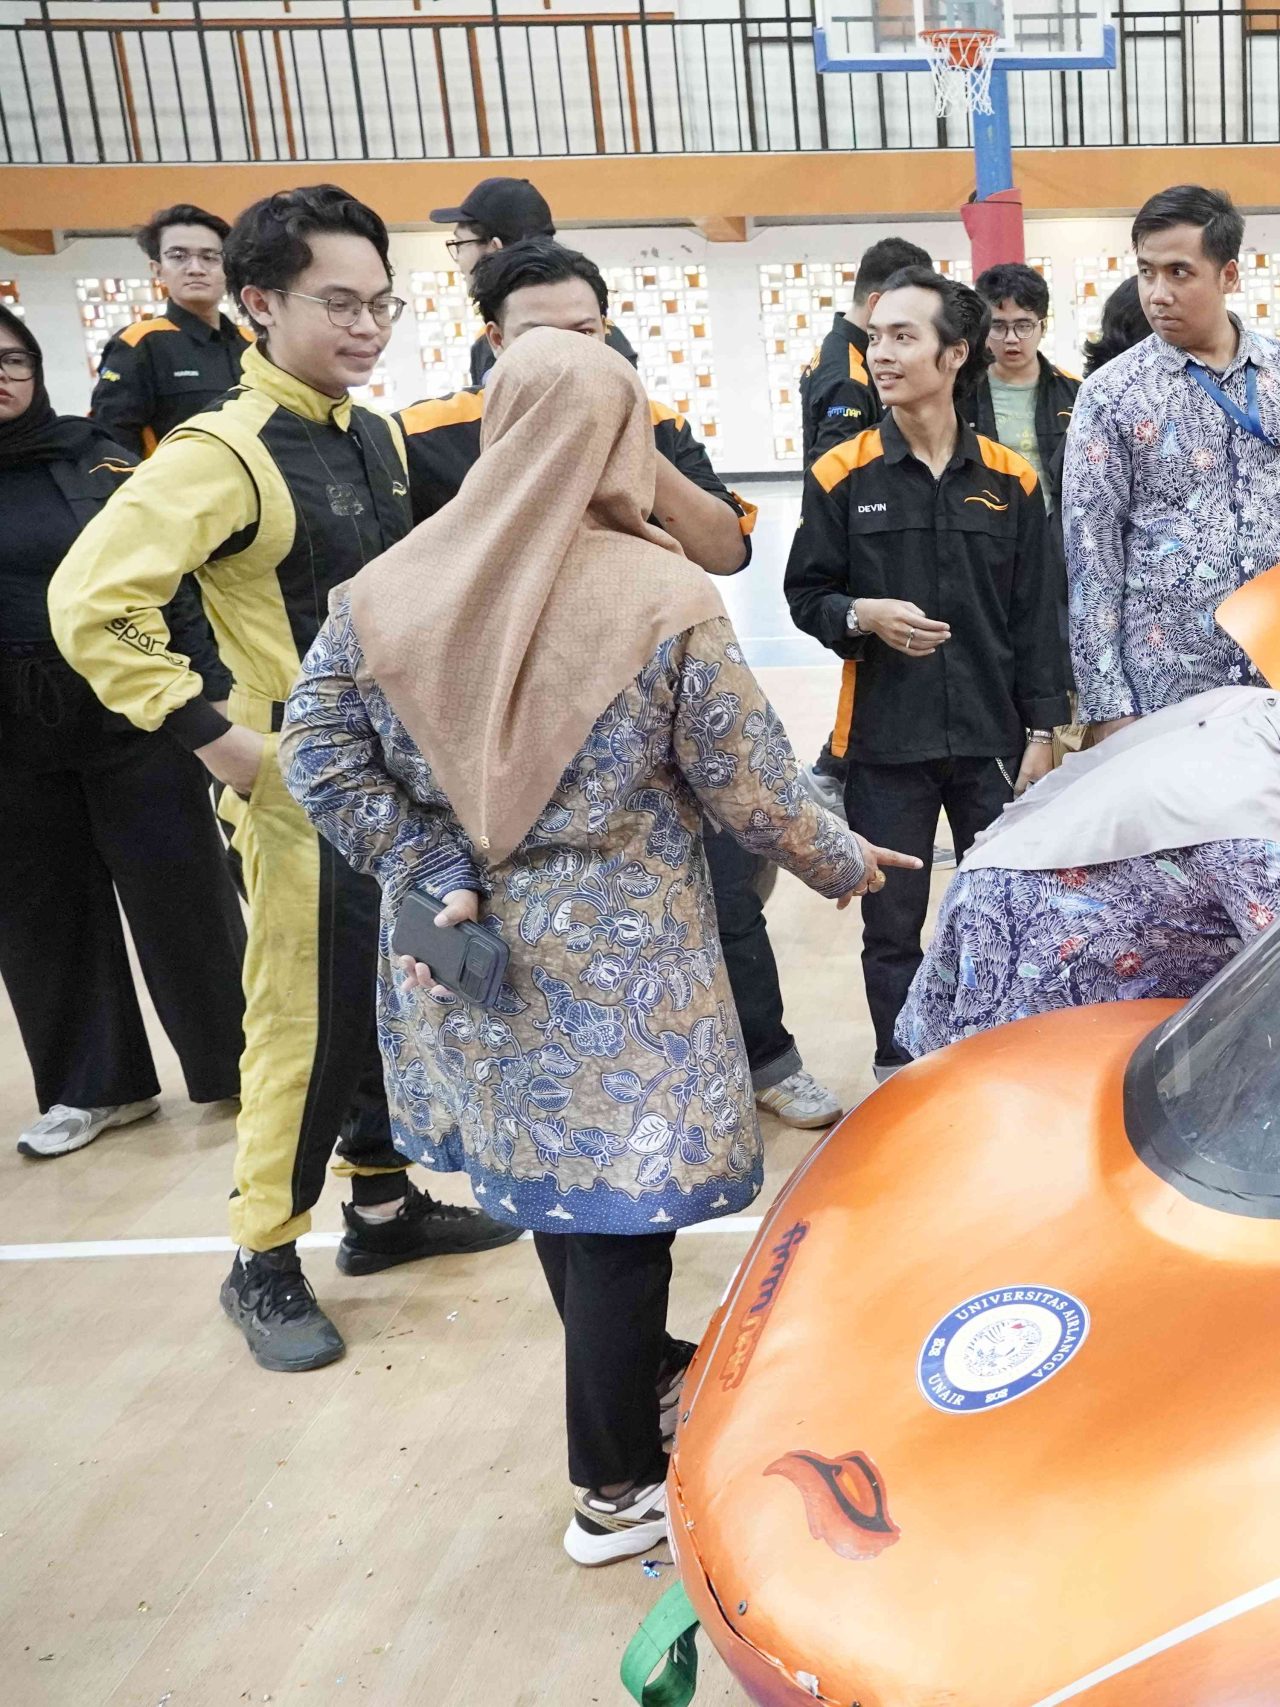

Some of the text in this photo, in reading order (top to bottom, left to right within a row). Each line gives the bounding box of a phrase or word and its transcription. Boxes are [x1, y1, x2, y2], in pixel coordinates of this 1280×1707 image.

[858, 503, 887, 513] DEVIN
[955, 1291, 1081, 1378] UNIVERSITAS AIRLANGGA
[928, 1373, 966, 1406] UNAIR
